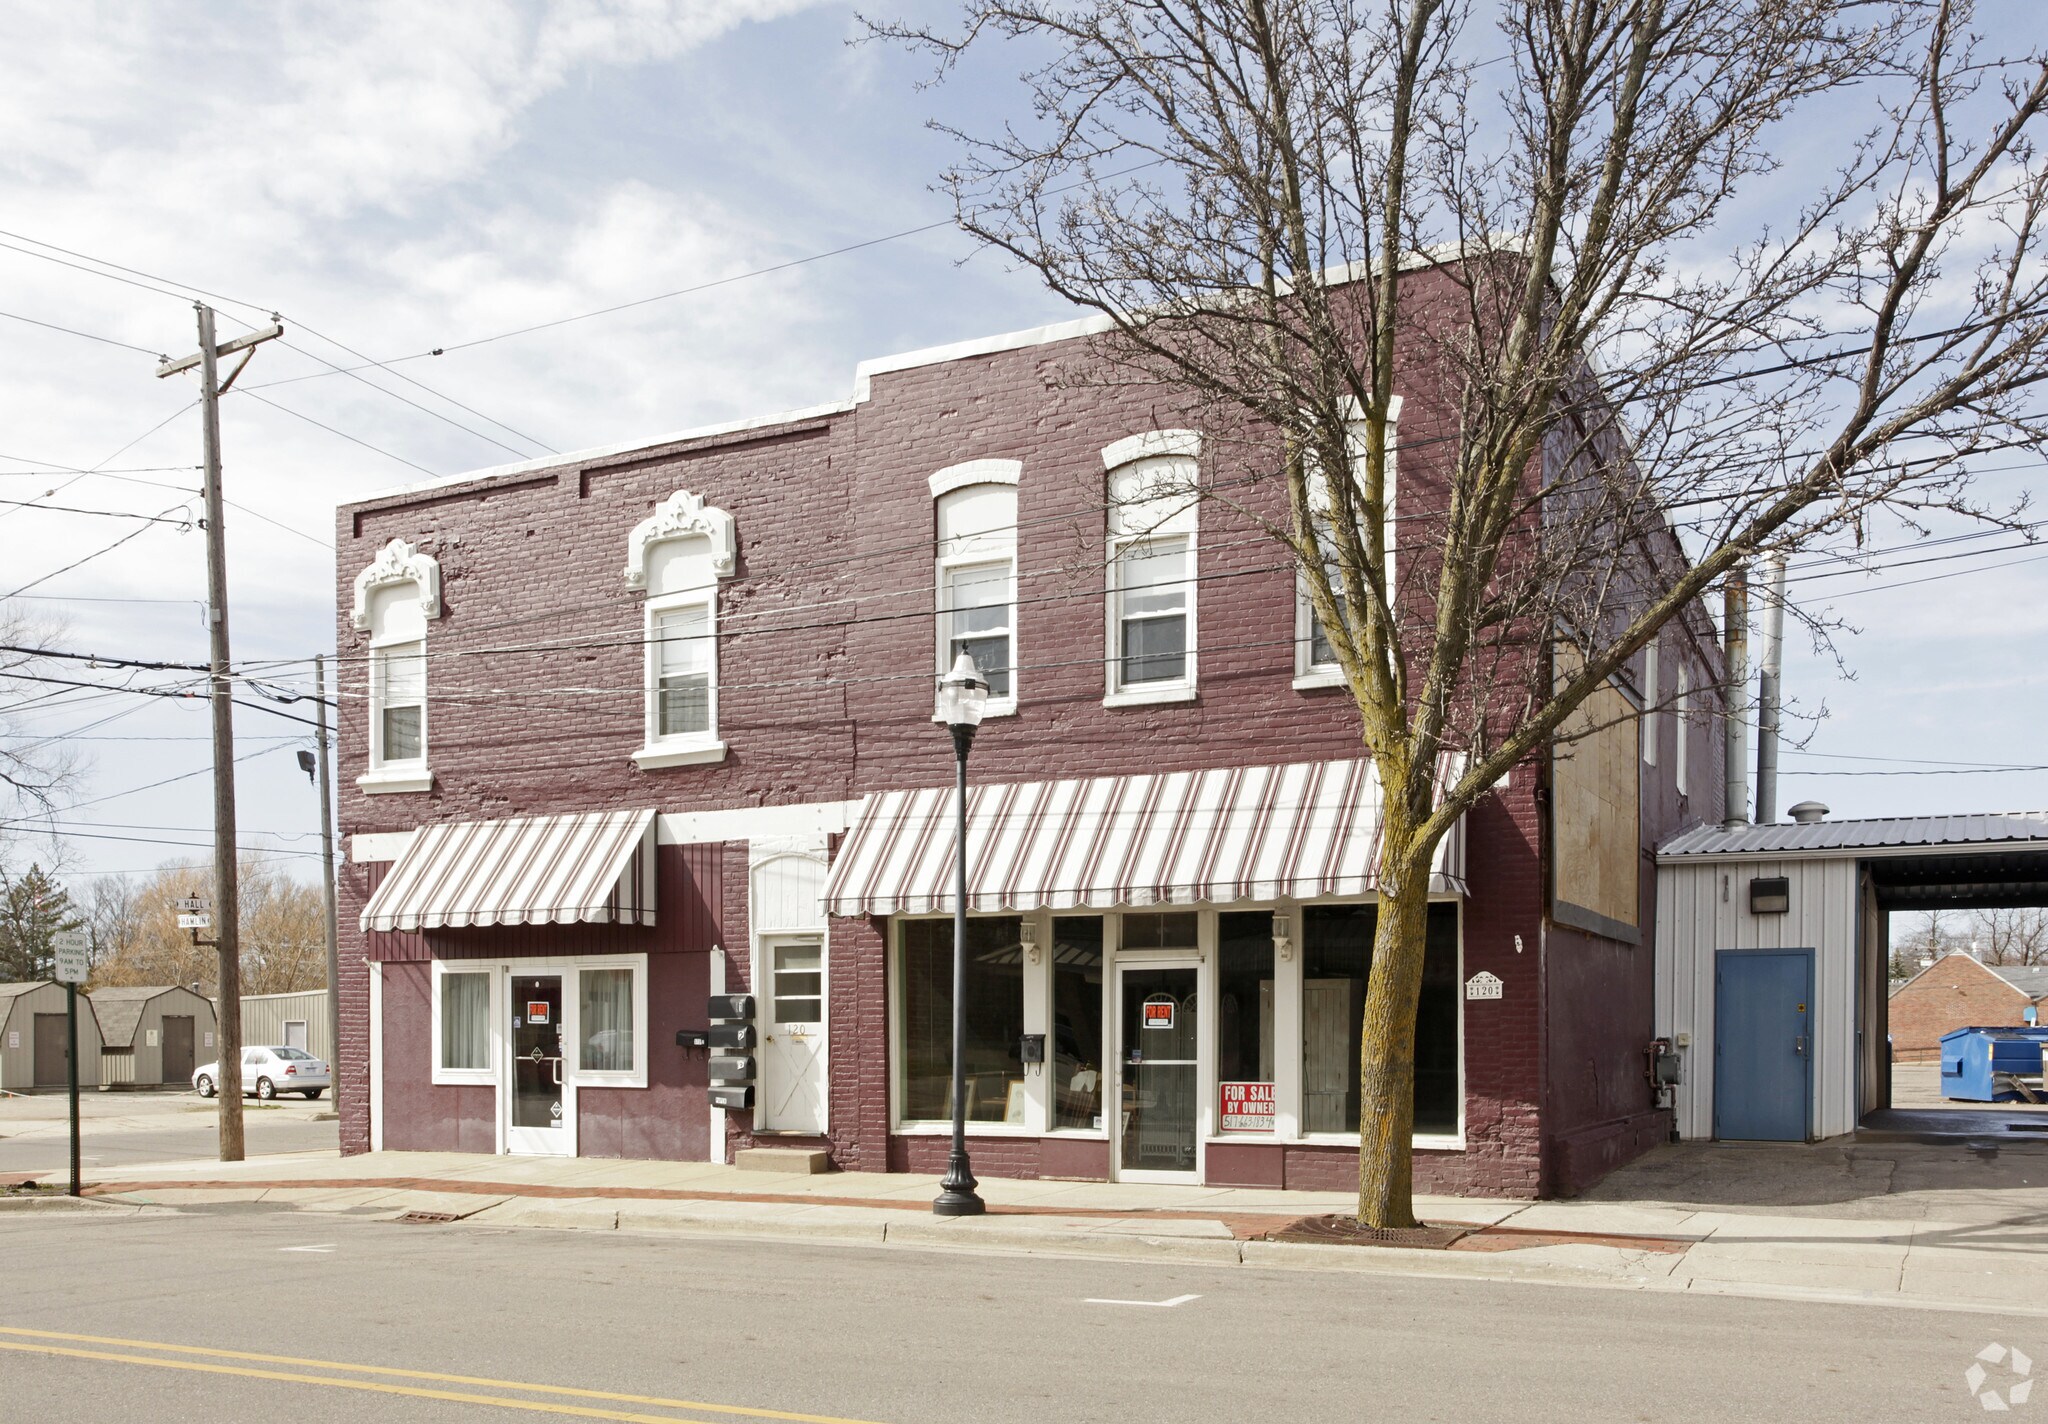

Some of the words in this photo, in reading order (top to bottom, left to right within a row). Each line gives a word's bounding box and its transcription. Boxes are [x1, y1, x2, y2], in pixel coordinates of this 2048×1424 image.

[184, 900, 204, 908] HALL
[58, 948, 84, 956] PARKING
[1475, 986, 1493, 996] 120
[537, 1004, 547, 1015] RENT
[1146, 1005, 1157, 1018] FOR
[1157, 1005, 1171, 1018] RENT
[788, 1024, 806, 1036] 120
[1225, 1086, 1245, 1101] FOR
[1227, 1102, 1239, 1113] BY
[1242, 1102, 1275, 1114] OWNER
